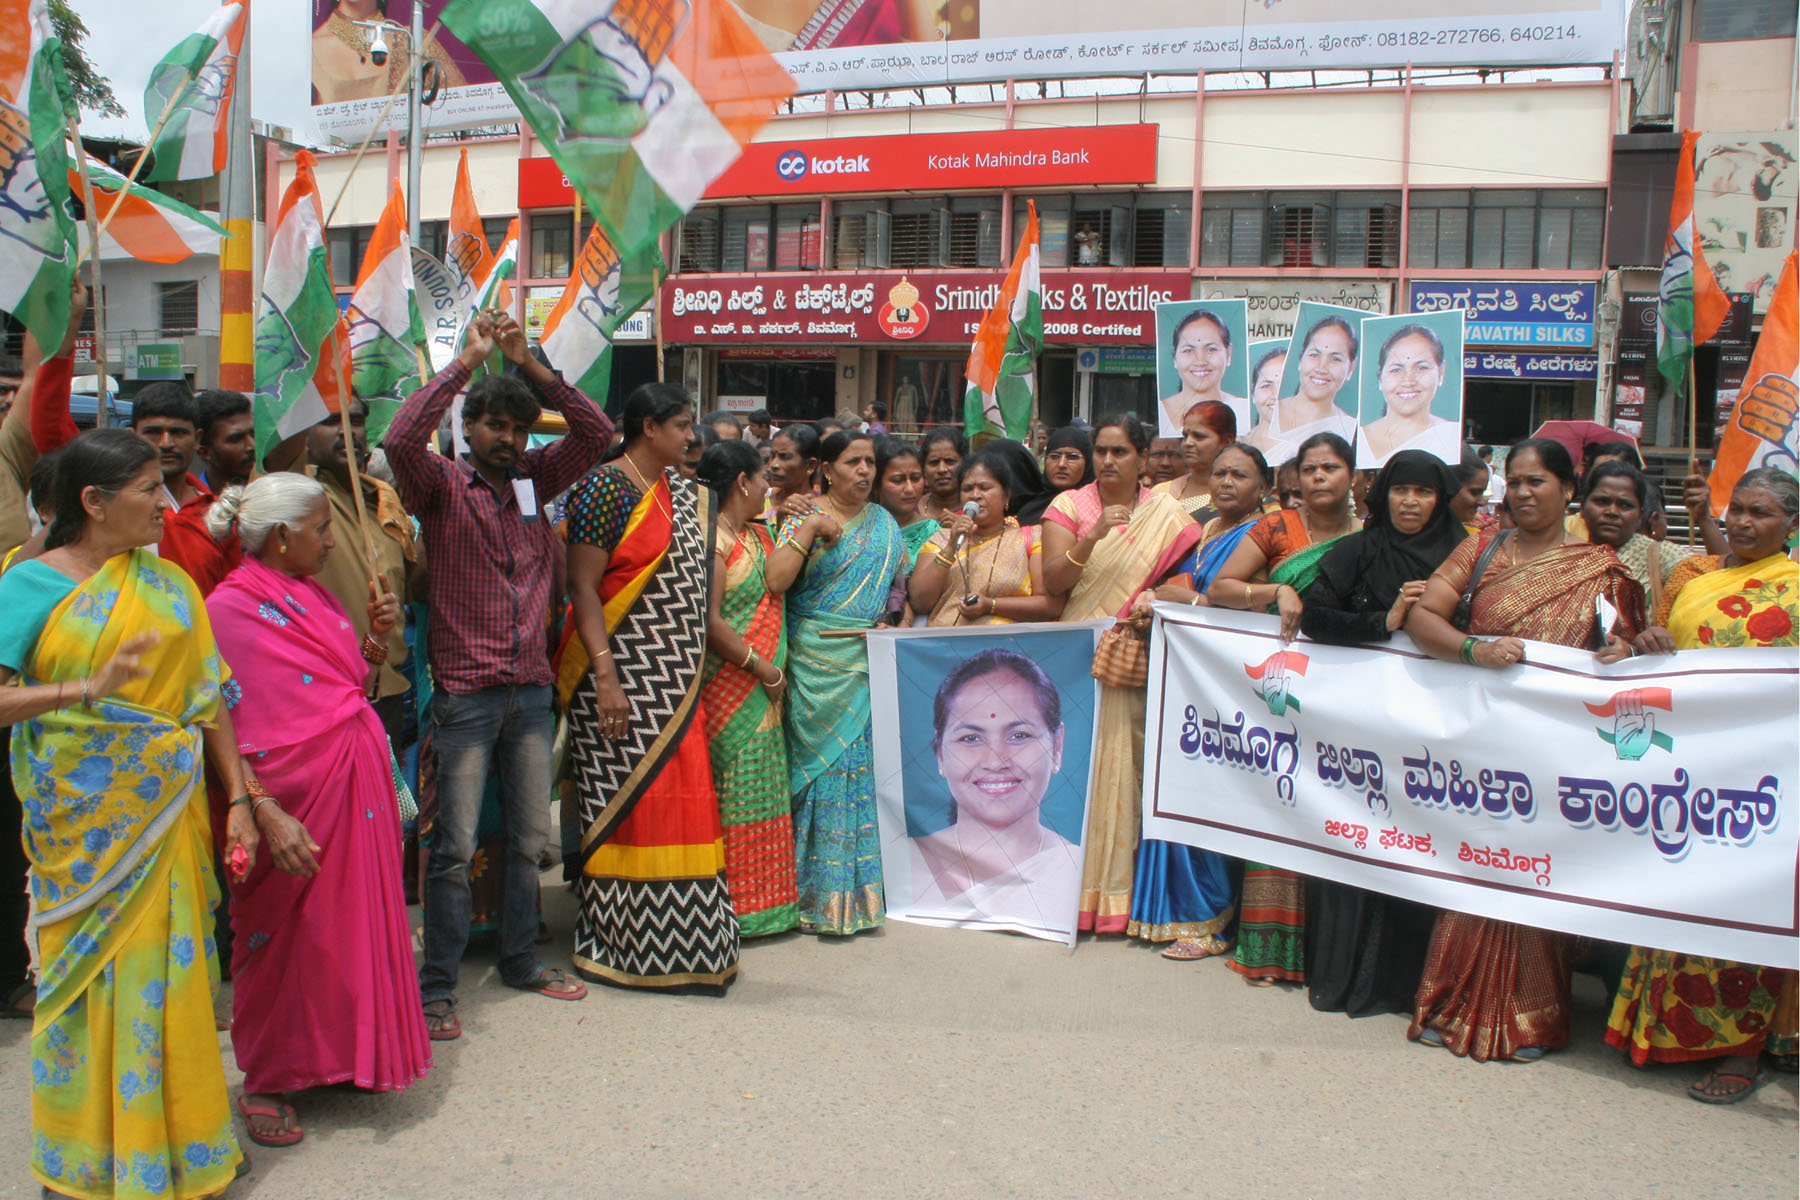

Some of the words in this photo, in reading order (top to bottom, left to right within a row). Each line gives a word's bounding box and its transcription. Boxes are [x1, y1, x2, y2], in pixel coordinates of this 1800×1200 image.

[920, 53, 948, 66] ಬಾಲ
[951, 51, 979, 65] ರಾಜ್
[1142, 40, 1188, 56] ಸರ್ಕಲ್
[1376, 28, 1505, 48] 08182-272766,
[1510, 24, 1581, 43] 640214.
[811, 153, 871, 176] kotak
[928, 152, 971, 170] Kotak
[975, 149, 1047, 168] Mahindra
[1051, 148, 1090, 165] Bank
[672, 287, 723, 316] ಶ್ರೀನಿಧಿ
[773, 289, 788, 311] &
[1041, 285, 1065, 311] ks
[1070, 283, 1087, 311] &
[1092, 283, 1173, 312] Textiles
[1416, 287, 1519, 319] ಭಾಗ್ಯವತಿ
[807, 321, 859, 338] ಶಿವಮೊಗ್ಗ
[1043, 323, 1079, 335] 2008
[1082, 323, 1143, 336] Certifed
[1463, 325, 1531, 341] YAVATHI
[1535, 326, 1587, 343] SILKS
[138, 354, 159, 368] ATM
[1179, 704, 1300, 804] ಶಿವಮೊಗ್ಗ
[1316, 740, 1391, 815] ಜಿಲ್ಲಾ
[1402, 744, 1535, 820] ಮಹಿಳಾ
[1557, 767, 1780, 860] ಕಾಂಗ್ರೇಸ್
[1324, 819, 1369, 849] ಜಿಲ್ಲಾ
[1379, 826, 1437, 857] ಘಟಕ,
[1457, 841, 1552, 887] ಶಿವಮೊಗ್ಗ
